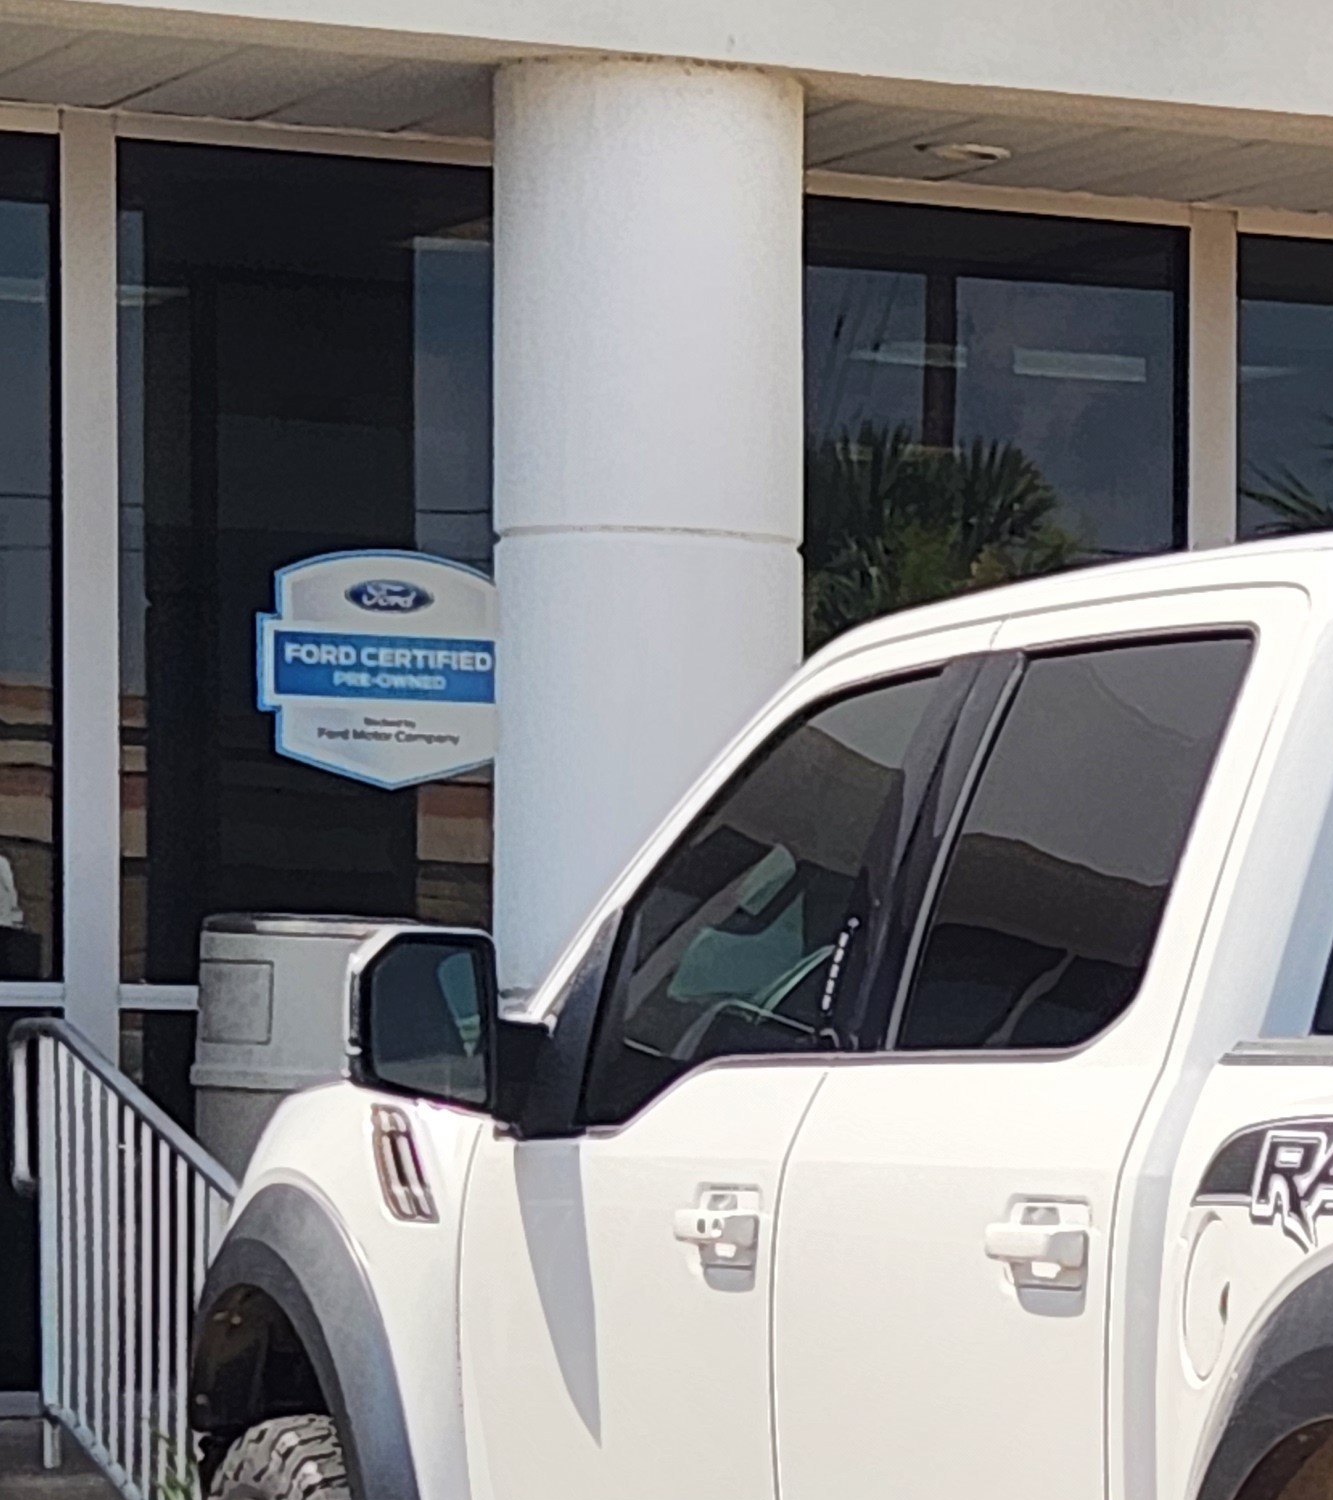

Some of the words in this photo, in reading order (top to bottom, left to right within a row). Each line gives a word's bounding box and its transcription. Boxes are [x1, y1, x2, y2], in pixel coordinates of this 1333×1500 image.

[362, 584, 417, 608] Ford
[284, 642, 356, 666] FORD
[360, 646, 492, 672] CERTIFIED
[333, 671, 447, 690] PRE-OWNED
[317, 727, 350, 741] Ford
[394, 730, 460, 746] Company
